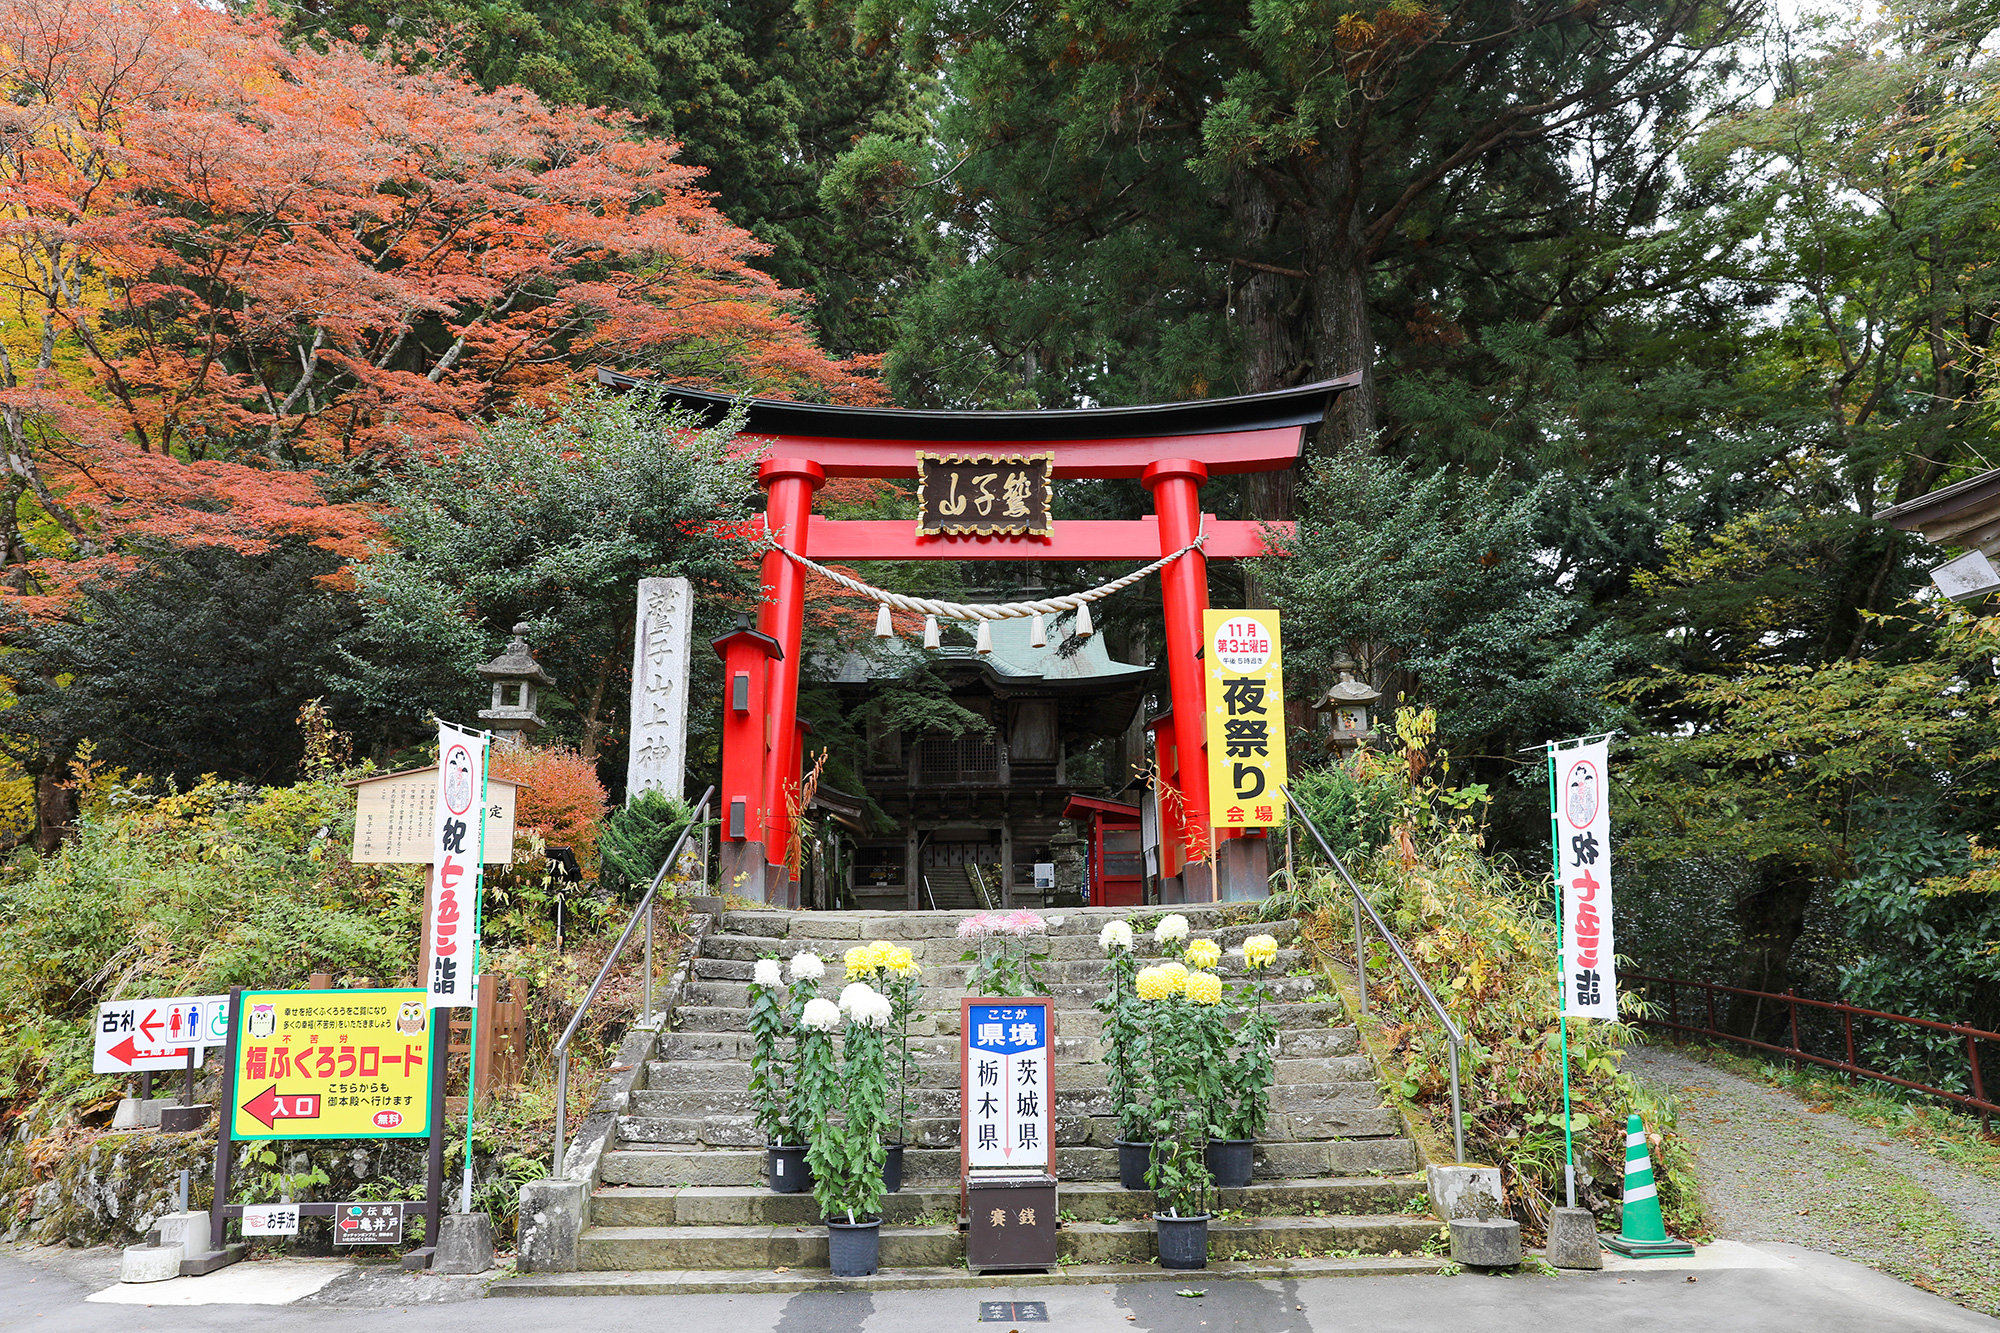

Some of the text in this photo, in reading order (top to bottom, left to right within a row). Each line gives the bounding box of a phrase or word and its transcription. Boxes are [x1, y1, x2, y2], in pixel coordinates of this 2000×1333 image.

[1228, 623, 1256, 637] 11月
[1218, 639, 1268, 653] 第3土曜日
[1222, 677, 1270, 800] 夜祭り
[489, 804, 503, 819] 定
[1226, 805, 1274, 822] 会場
[433, 817, 467, 995] 祝七五三詣
[102, 1009, 135, 1033] 古札
[987, 1009, 1028, 1020] ここが
[976, 1023, 1038, 1047] 県境
[246, 1044, 423, 1080] 福ふくろうロード
[328, 1083, 390, 1093] こちらからも
[270, 1098, 313, 1116] 入口
[327, 1095, 413, 1107] 御本殿へ行けます
[977, 1059, 999, 1151] 栃木県
[1017, 1059, 1039, 1151] 茨城県
[377, 1113, 400, 1125] 無料
[367, 1205, 394, 1216] 伝説
[989, 1207, 1036, 1228] 賽銭
[266, 1211, 296, 1229] お手洗
[360, 1216, 399, 1231] 亀井戸
